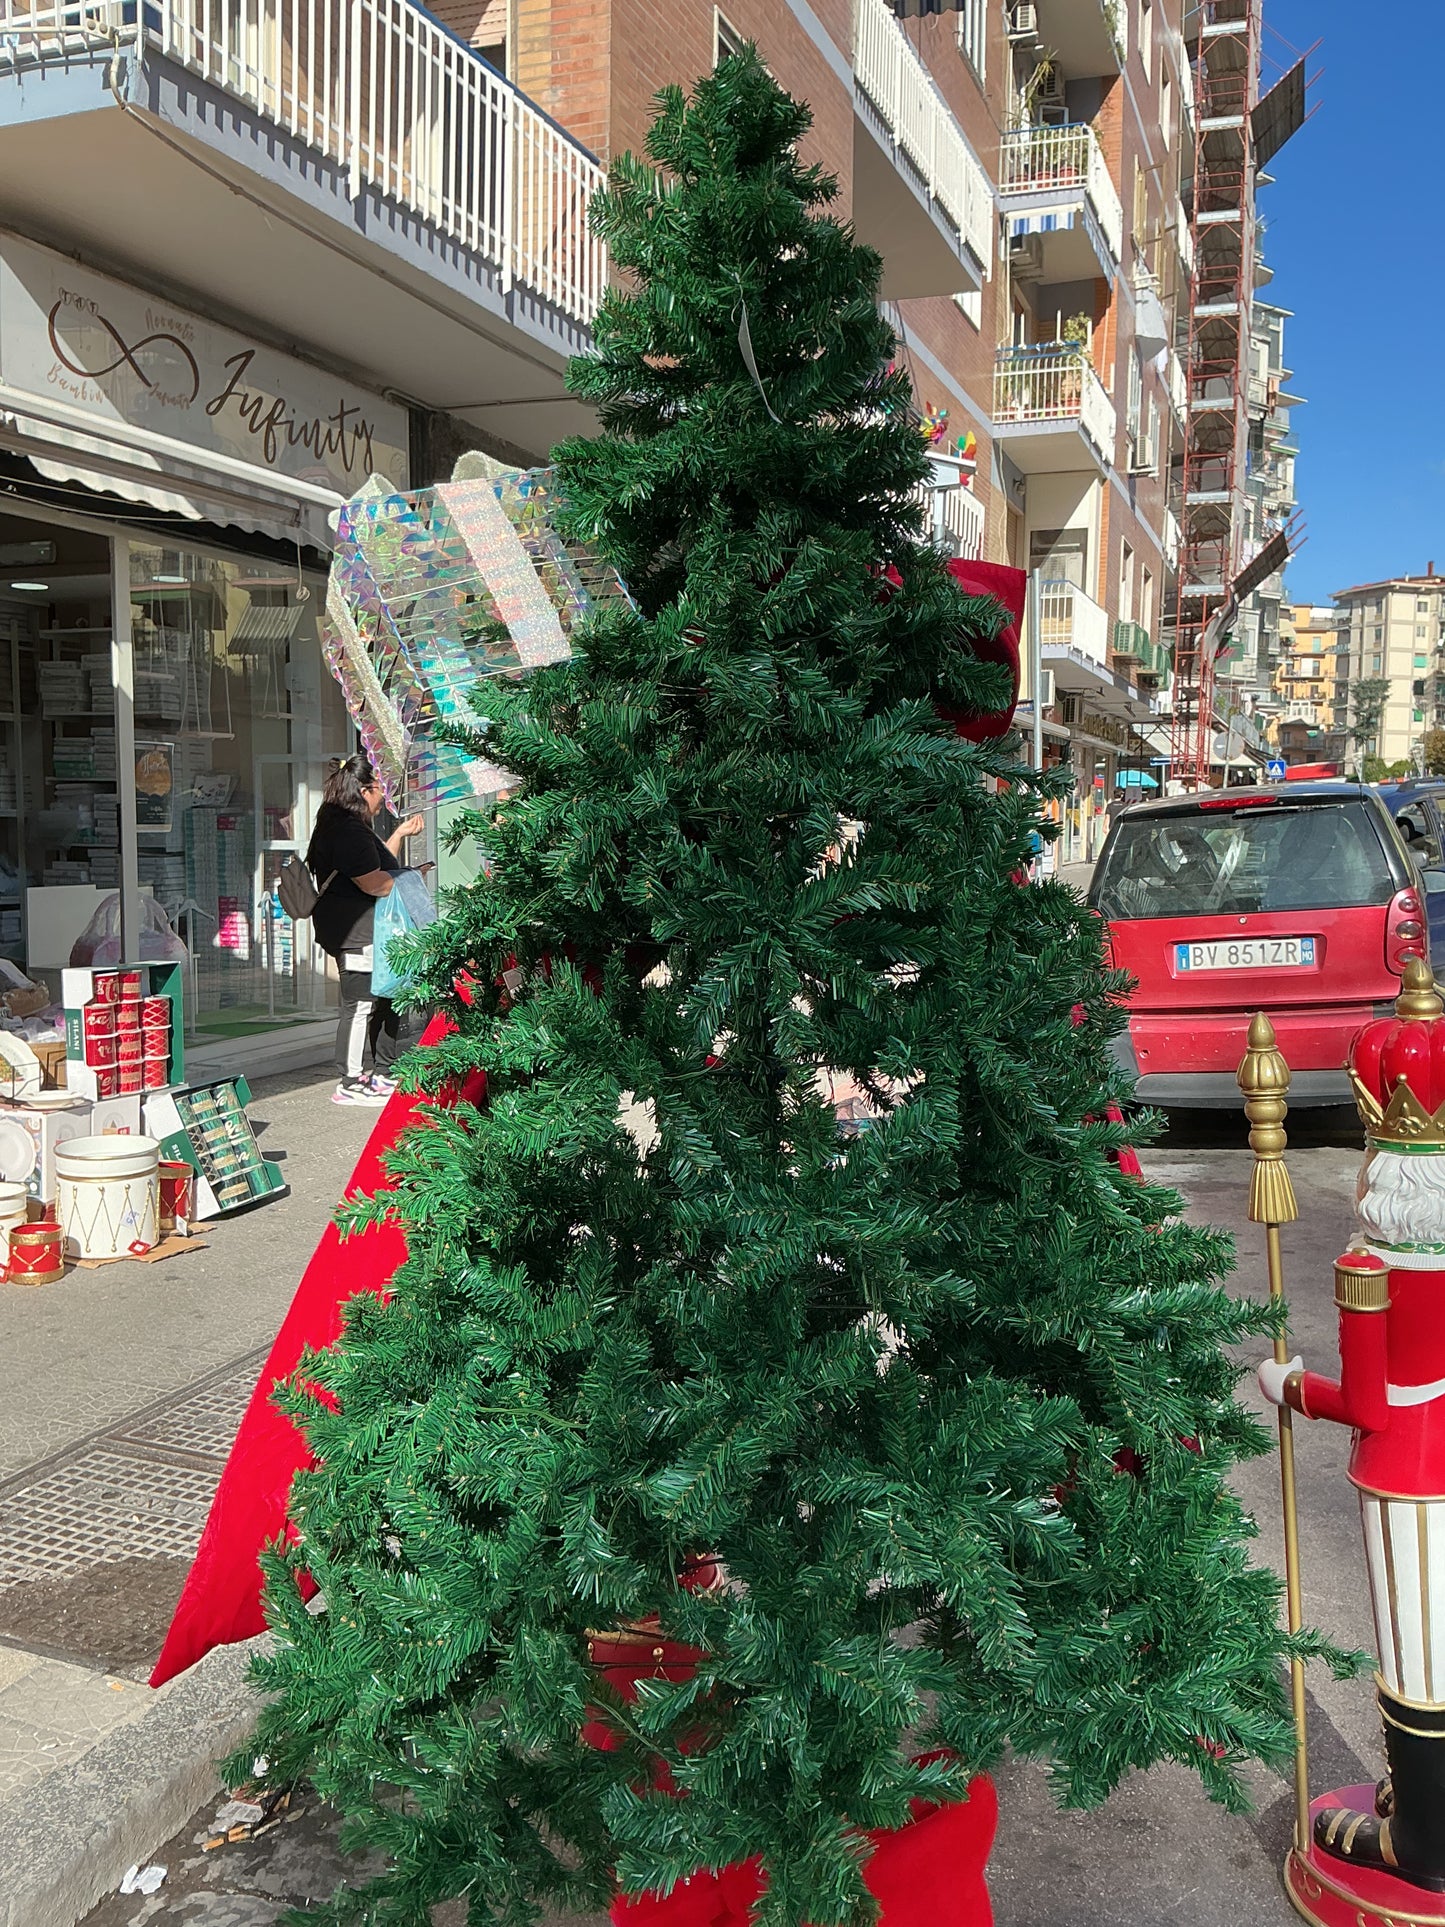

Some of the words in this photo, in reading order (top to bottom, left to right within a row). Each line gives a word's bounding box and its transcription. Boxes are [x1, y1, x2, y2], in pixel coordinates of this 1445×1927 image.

[206, 349, 375, 476] Infinity
[1192, 945, 1218, 967] BV
[1227, 941, 1298, 966] 851ZR
[1301, 950, 1313, 962] MO
[171, 1143, 184, 1163] SILA
